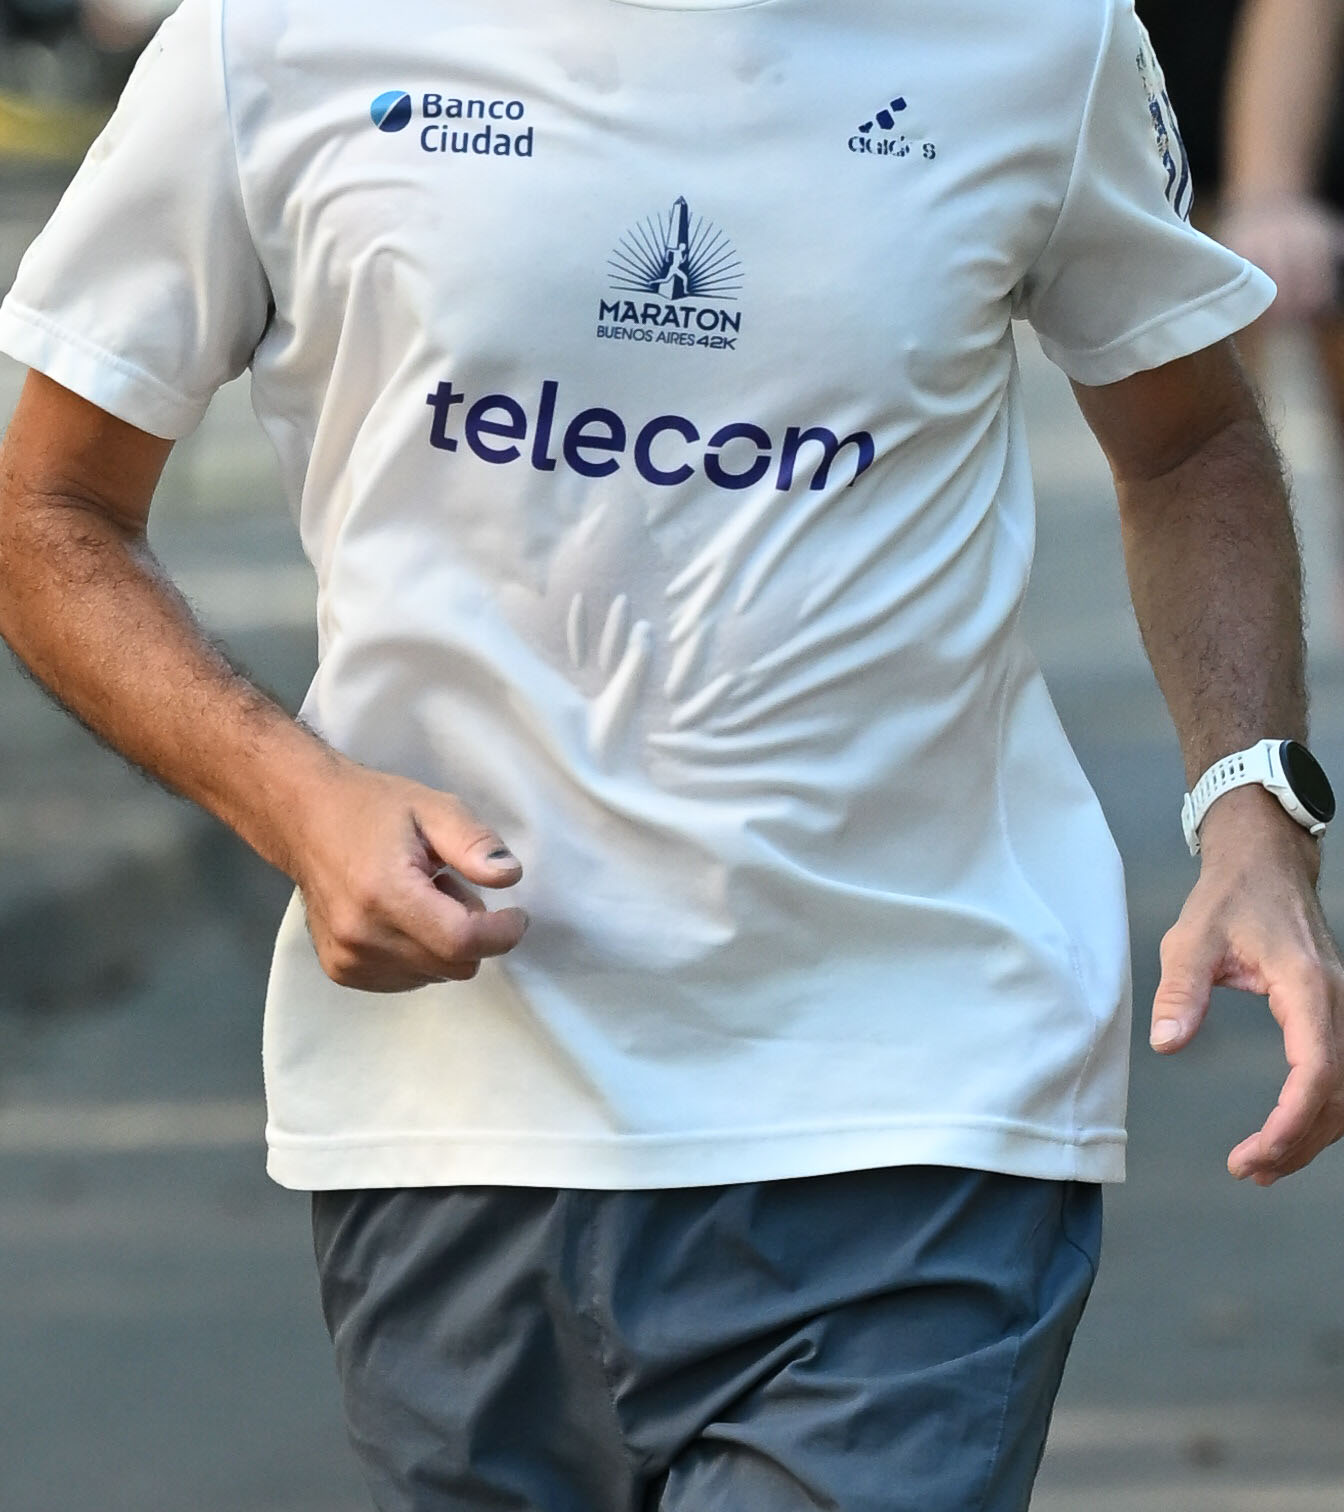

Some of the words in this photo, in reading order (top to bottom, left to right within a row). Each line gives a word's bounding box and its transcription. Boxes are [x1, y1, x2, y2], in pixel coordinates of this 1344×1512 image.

[422, 92, 525, 121] Banco
[420, 125, 534, 158] Ciudad
[599, 298, 742, 333] MARATON
[597, 325, 654, 343] BUENOS
[655, 330, 696, 347] AIRES
[696, 335, 738, 351] 42K
[426, 380, 875, 492] telecom
